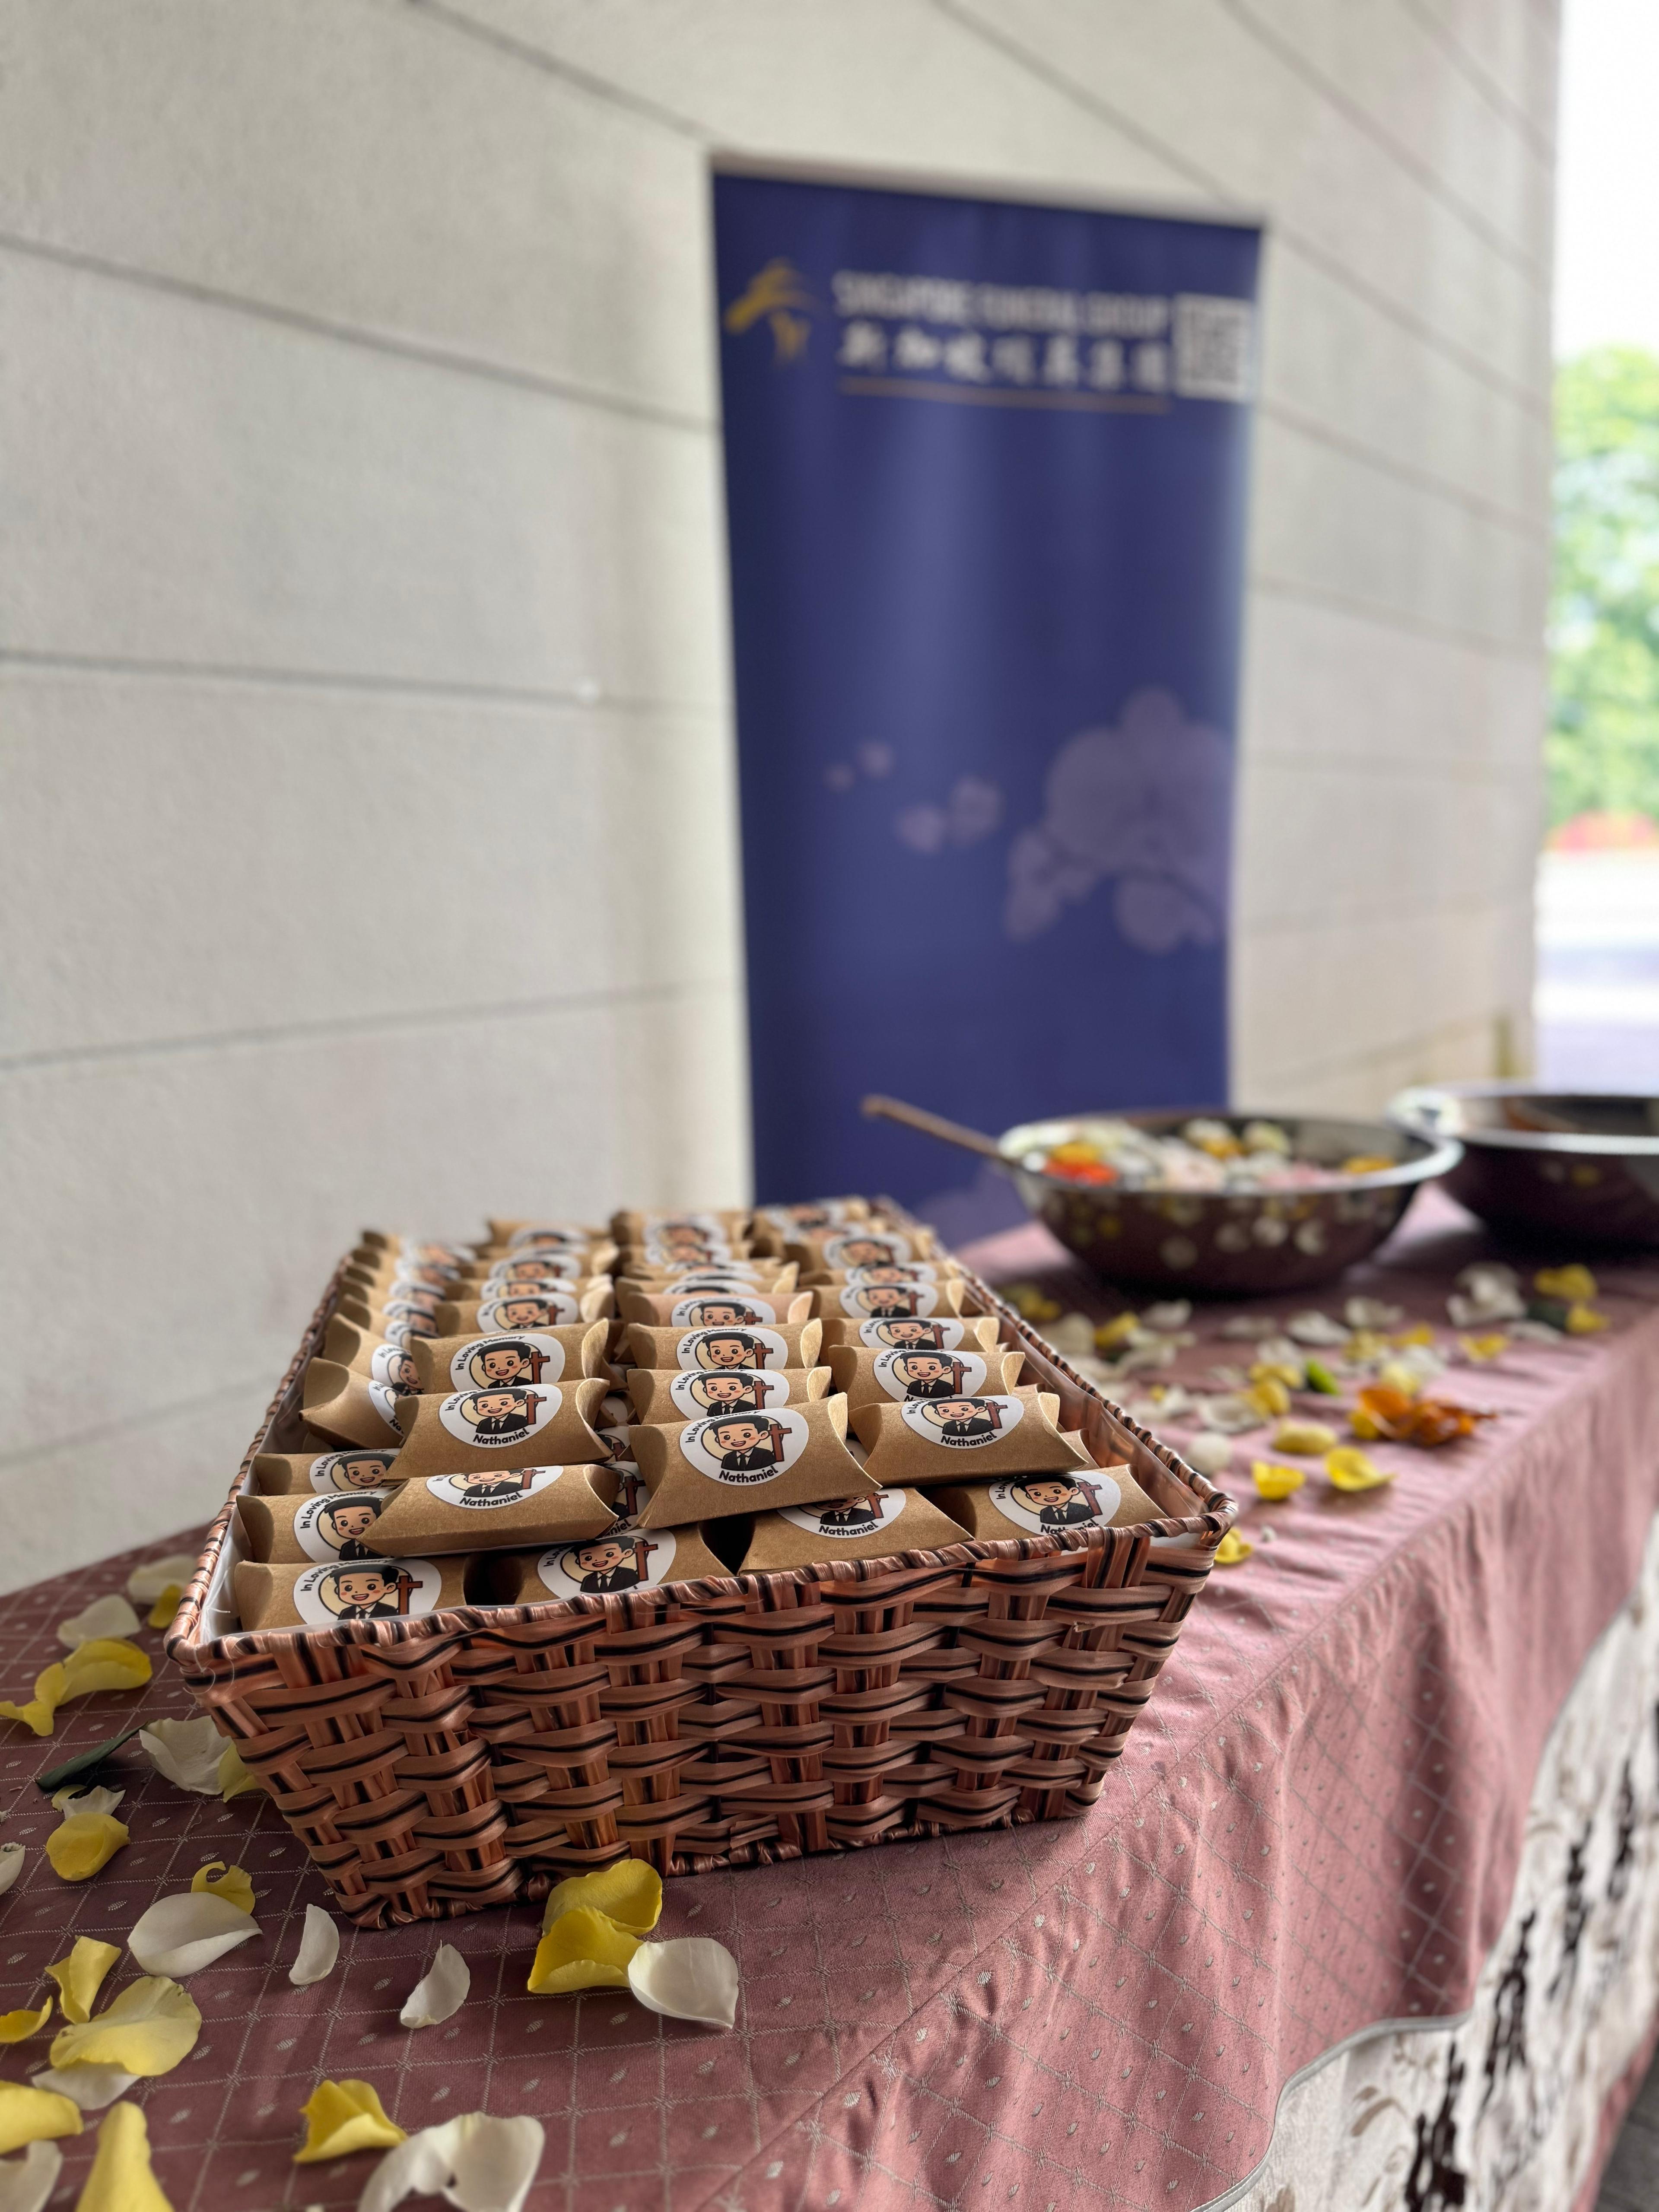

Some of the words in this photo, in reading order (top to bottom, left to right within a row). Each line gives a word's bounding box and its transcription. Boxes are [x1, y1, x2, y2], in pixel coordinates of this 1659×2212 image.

[683, 1332, 707, 1347] Loving
[457, 1342, 483, 1362] Loving
[484, 1336, 525, 1344] Memory
[677, 1371, 705, 1383] Loving
[687, 1418, 715, 1435] Loving
[473, 1428, 530, 1445] Nathaniel
[941, 1432, 997, 1446] Nathaniel
[316, 1453, 344, 1469] Loving
[719, 1465, 779, 1483] Nathaniel
[302, 1498, 330, 1519] Loving
[328, 1491, 377, 1500] Memory
[459, 1492, 523, 1506] Nathaniel
[819, 1521, 879, 1536] Nathaniel
[304, 1565, 339, 1582] Loving
